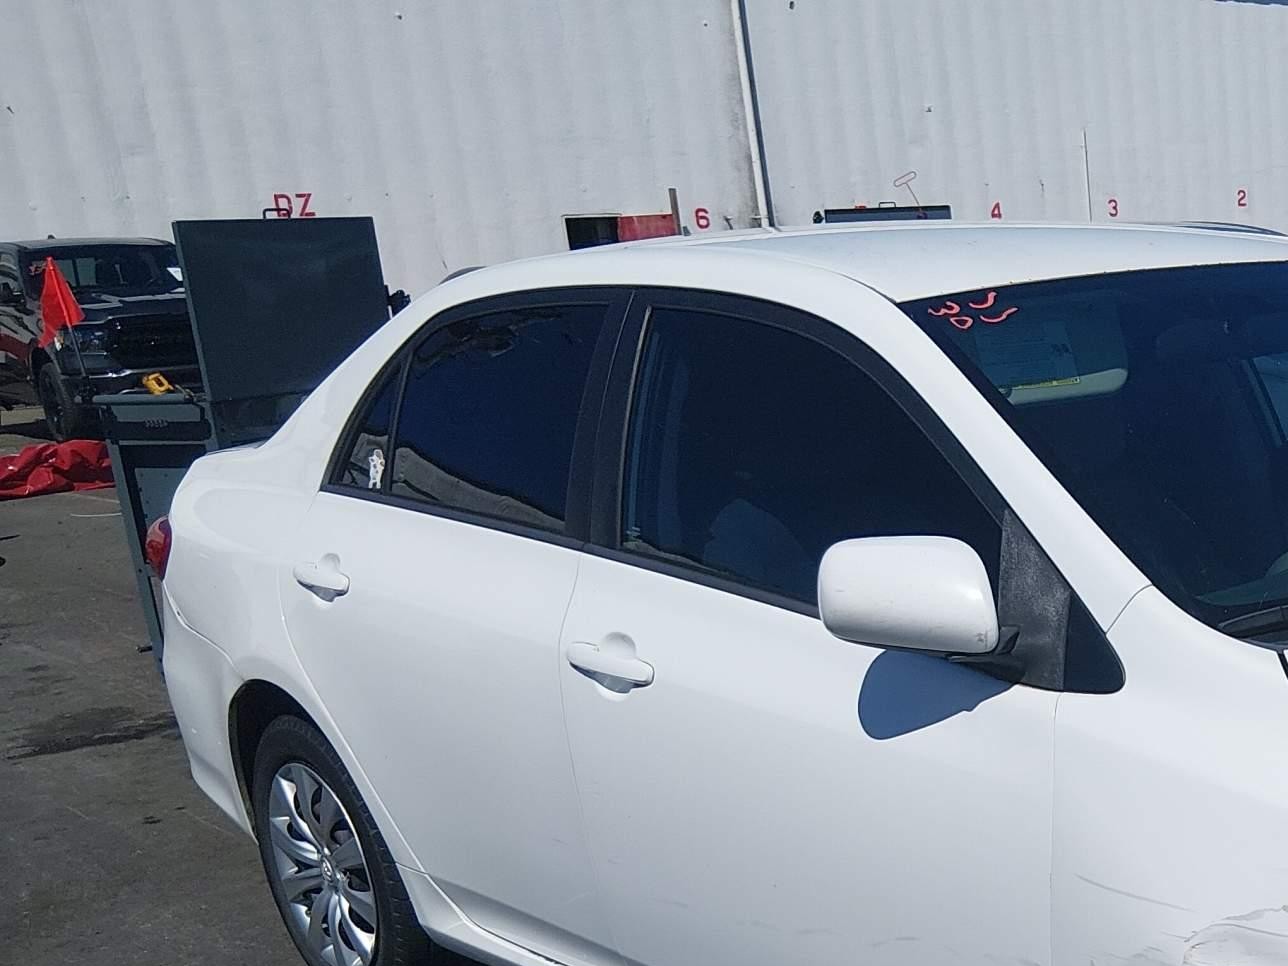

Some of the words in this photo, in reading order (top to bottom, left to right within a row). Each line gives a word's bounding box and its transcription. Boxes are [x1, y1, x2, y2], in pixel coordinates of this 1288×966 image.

[273, 193, 316, 217] DZ
[1236, 189, 1247, 207] 2
[991, 201, 1002, 219] 4
[1107, 199, 1119, 218] 3
[695, 208, 710, 229] 6
